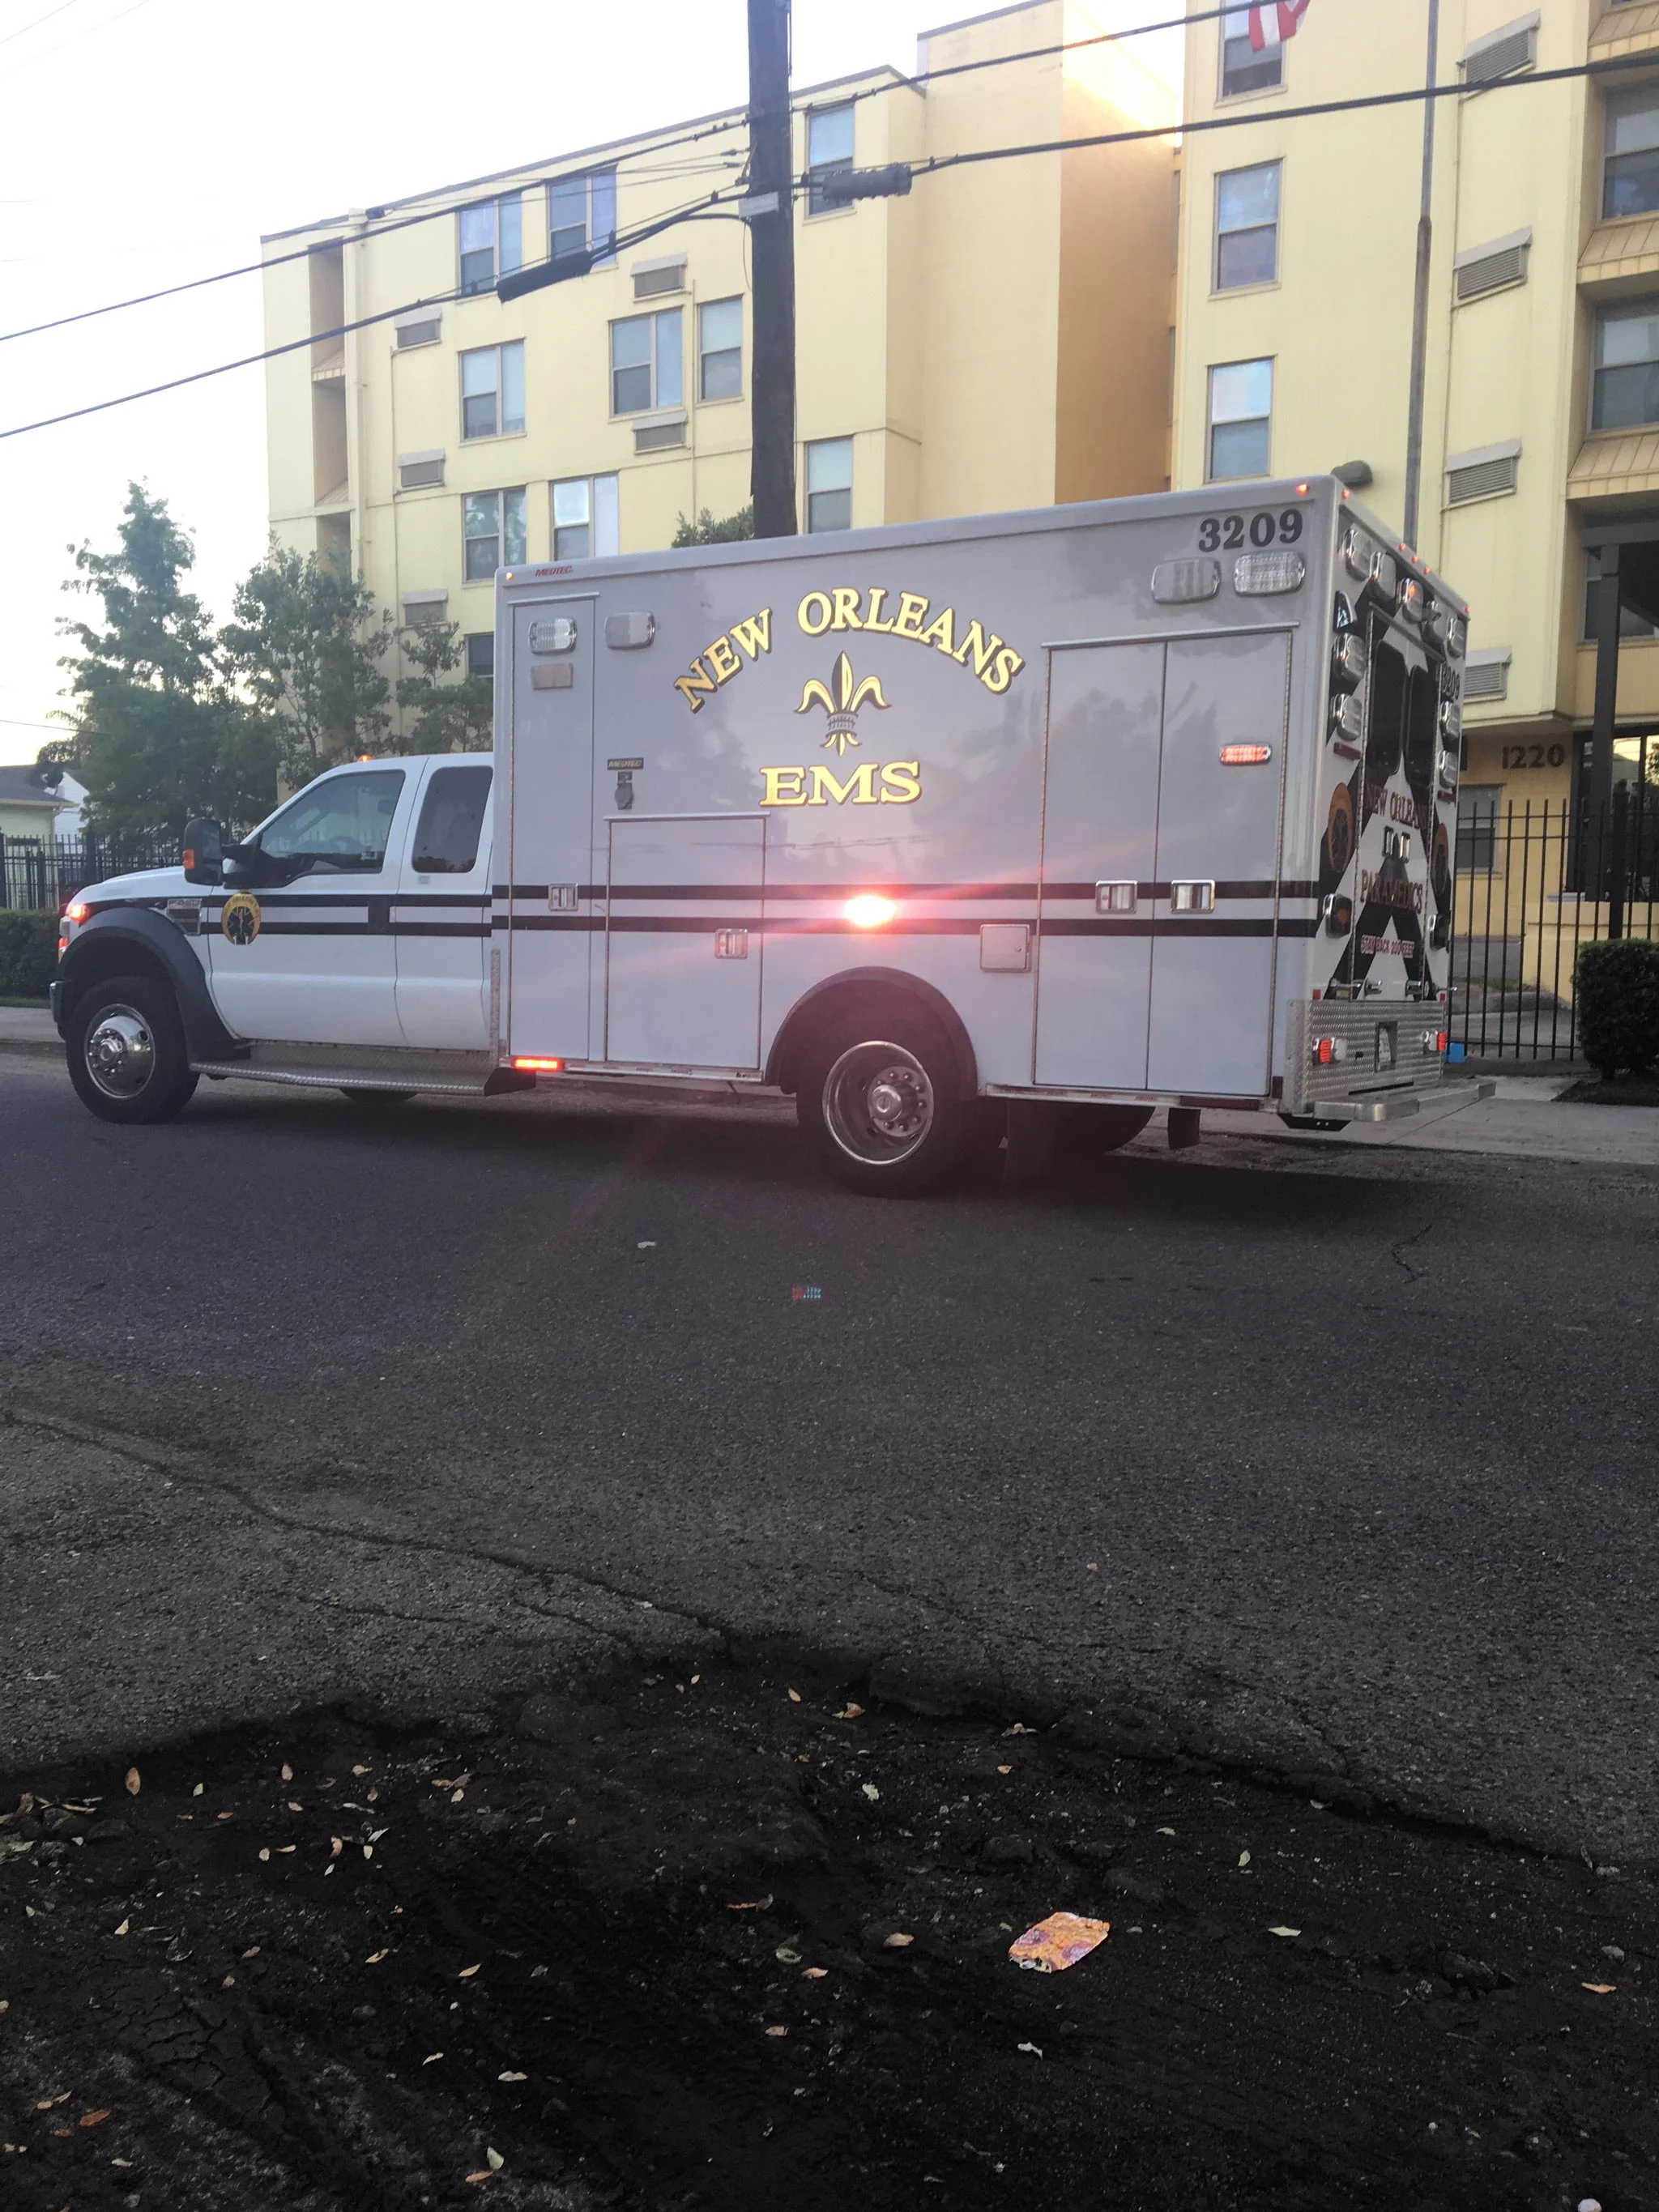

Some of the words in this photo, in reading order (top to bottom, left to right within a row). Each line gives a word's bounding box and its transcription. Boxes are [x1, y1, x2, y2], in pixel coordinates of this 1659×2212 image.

[1198, 509, 1303, 552] 3209
[673, 607, 773, 713] NEW
[796, 587, 1026, 695] ORLEANS
[1502, 743, 1566, 769] 1220
[758, 760, 923, 807] EMS
[1390, 791, 1428, 830] ORLEAN
